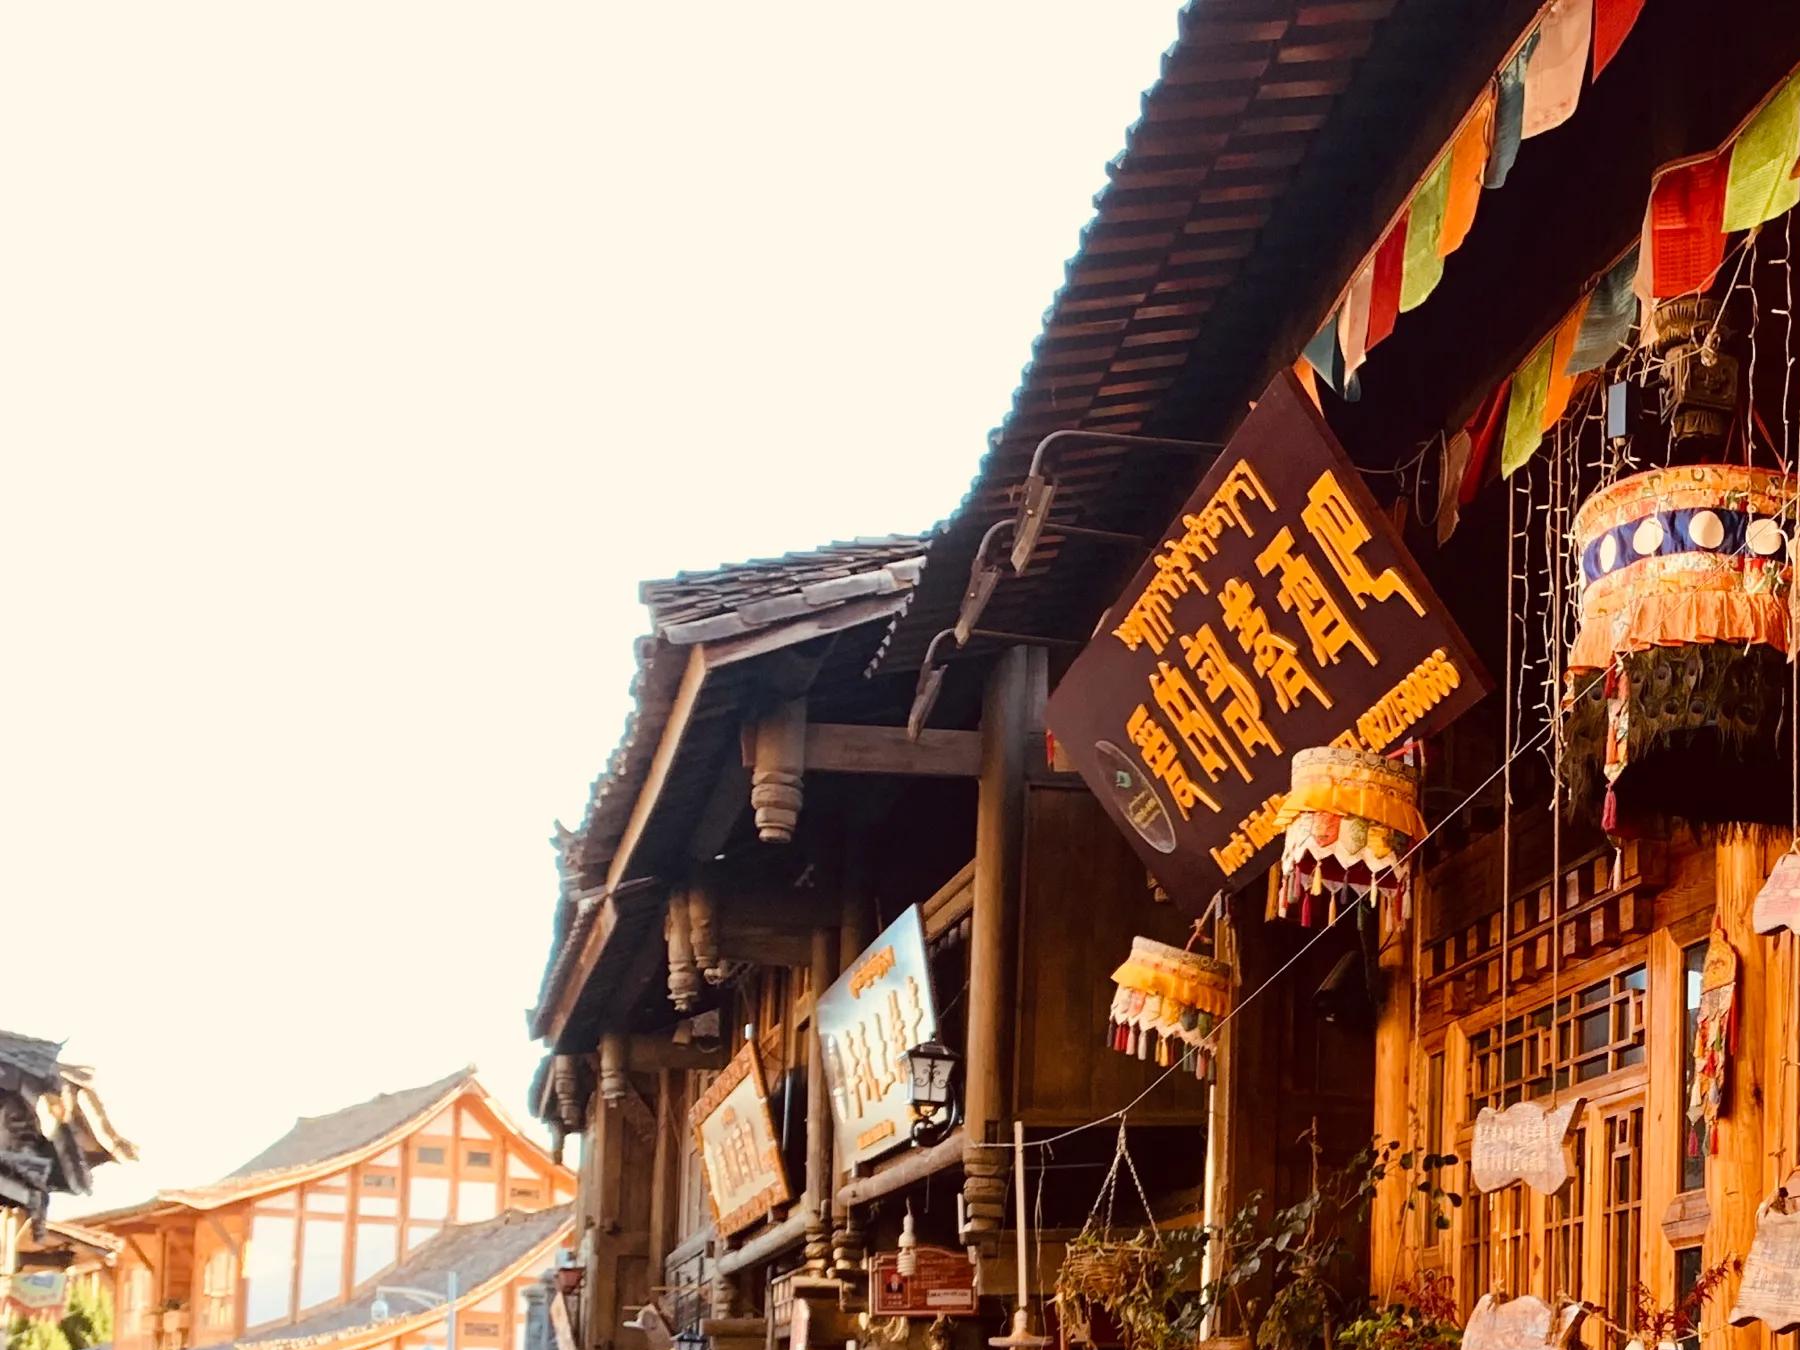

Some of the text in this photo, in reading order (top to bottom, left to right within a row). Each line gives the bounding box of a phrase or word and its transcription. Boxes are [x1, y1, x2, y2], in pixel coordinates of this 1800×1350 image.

[1126, 469, 1427, 822] 爱的部落酒吧
